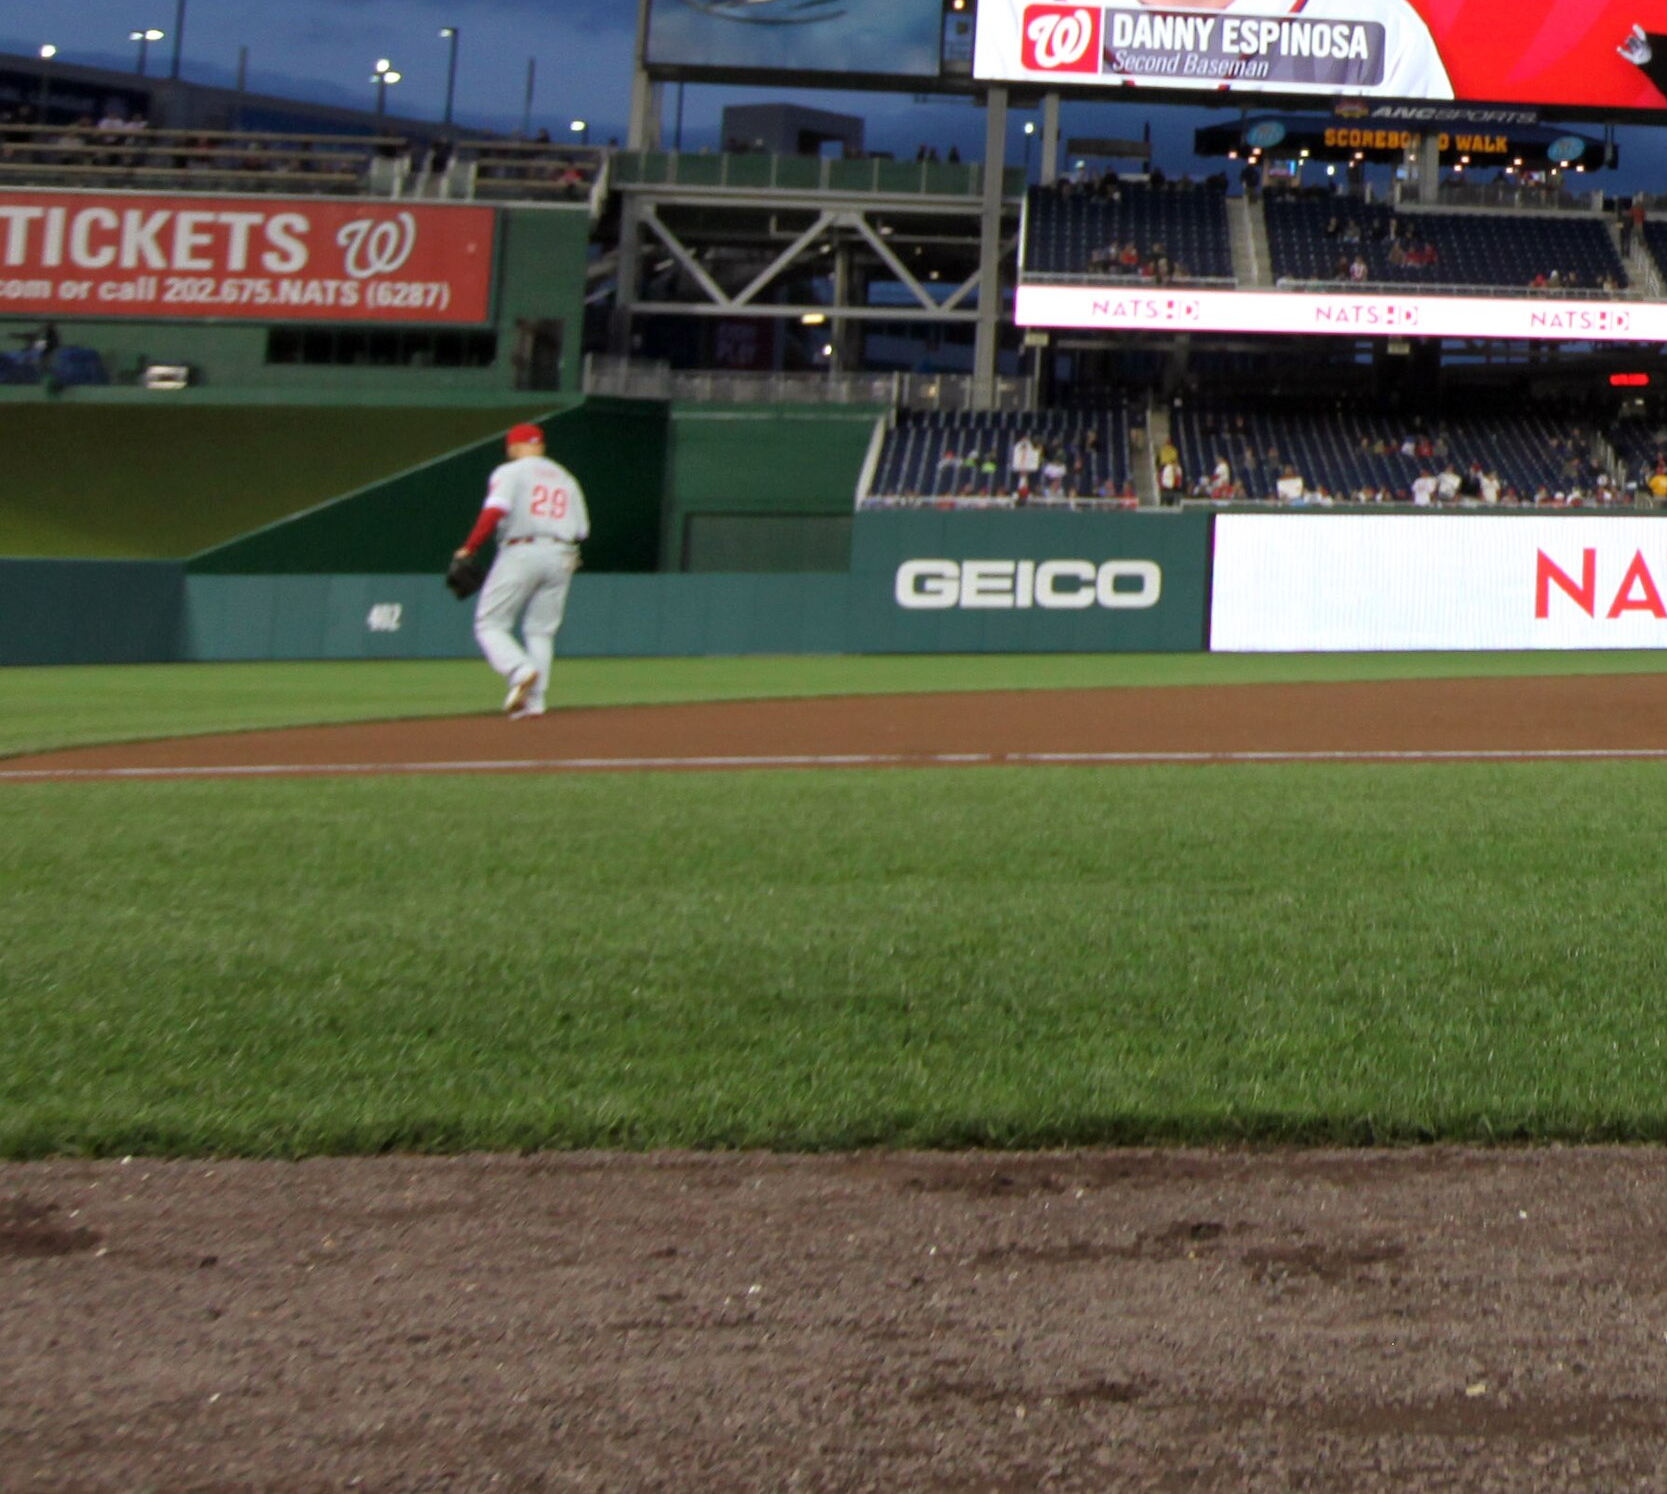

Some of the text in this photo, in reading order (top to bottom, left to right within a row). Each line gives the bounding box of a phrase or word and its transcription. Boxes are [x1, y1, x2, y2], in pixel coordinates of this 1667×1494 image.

[1112, 13, 1369, 60] DANNY ESPINOSA
[1112, 49, 1269, 78] Second Baseman
[1455, 135, 1508, 153] WALK
[0, 205, 311, 274] TICKETS
[59, 279, 94, 302] or
[97, 276, 156, 302] call
[162, 276, 359, 307] 202.675.NATS
[366, 280, 451, 311] (6287)
[529, 484, 569, 520] 29
[895, 559, 1162, 609] GEICO
